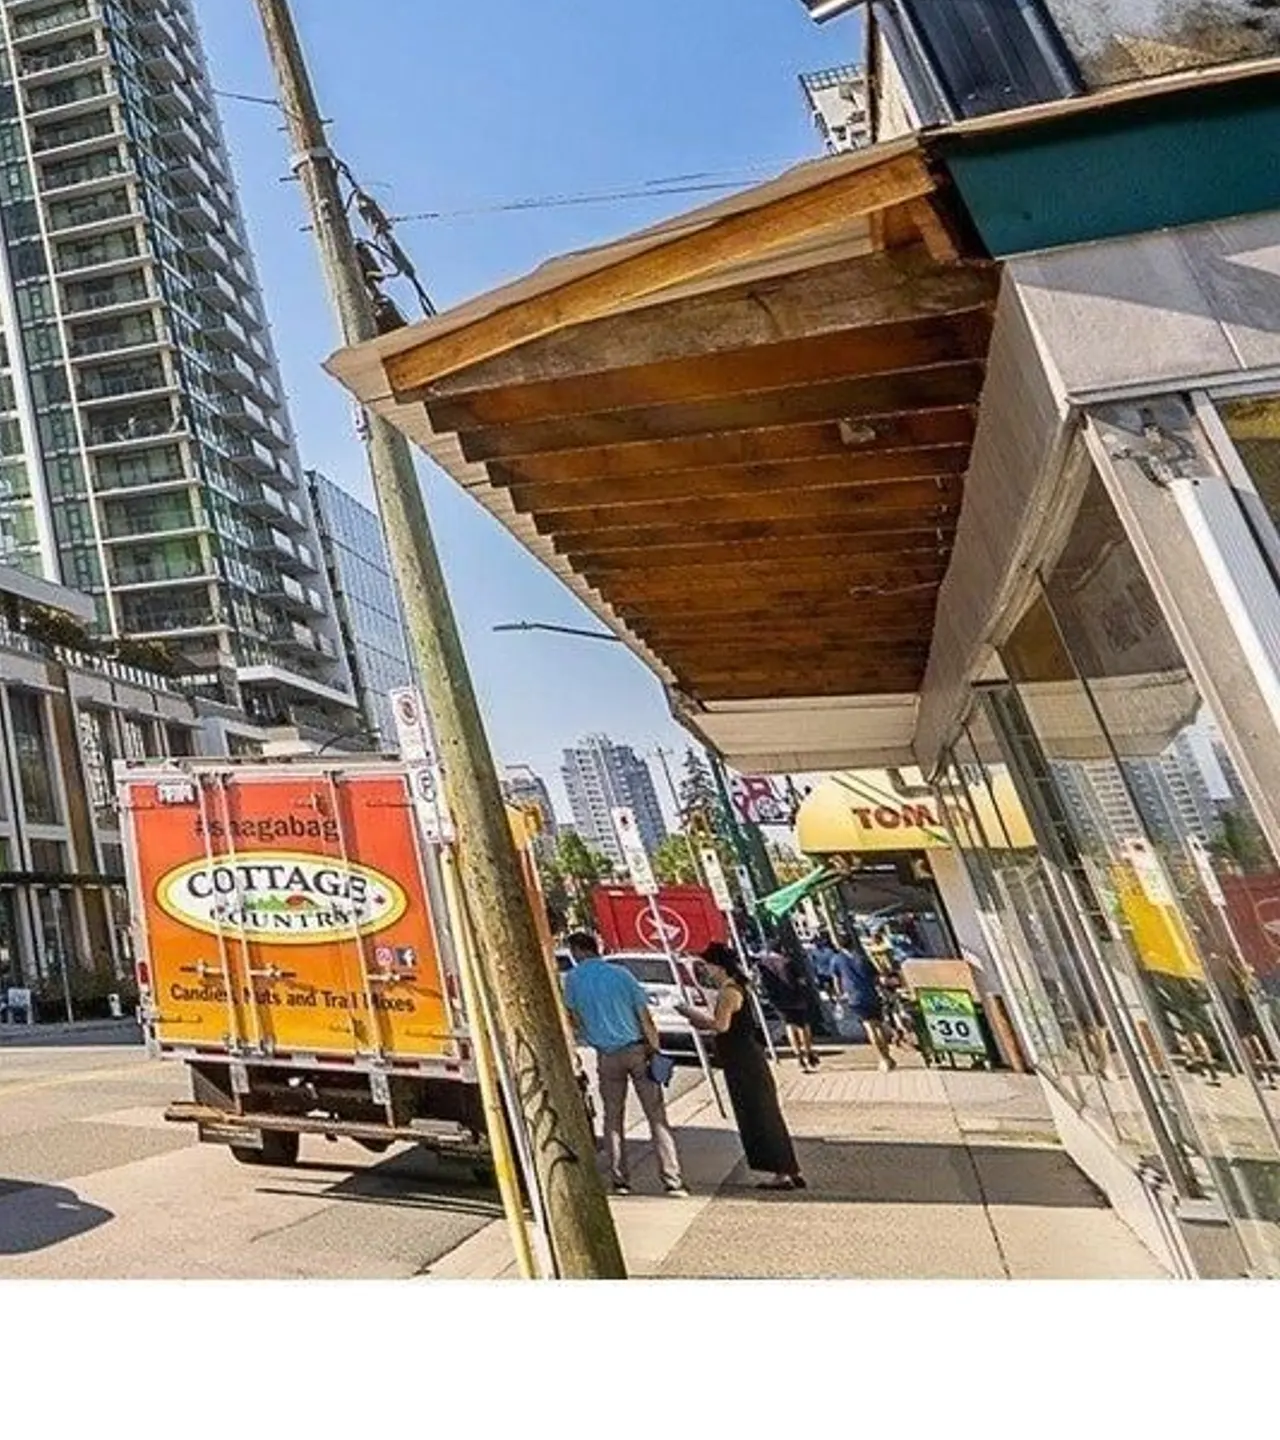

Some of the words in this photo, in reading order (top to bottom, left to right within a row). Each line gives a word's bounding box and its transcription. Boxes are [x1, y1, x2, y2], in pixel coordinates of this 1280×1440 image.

[187, 864, 368, 904] COTTAGE
[209, 905, 352, 928] COUNTRY
[287, 990, 316, 1007] and
